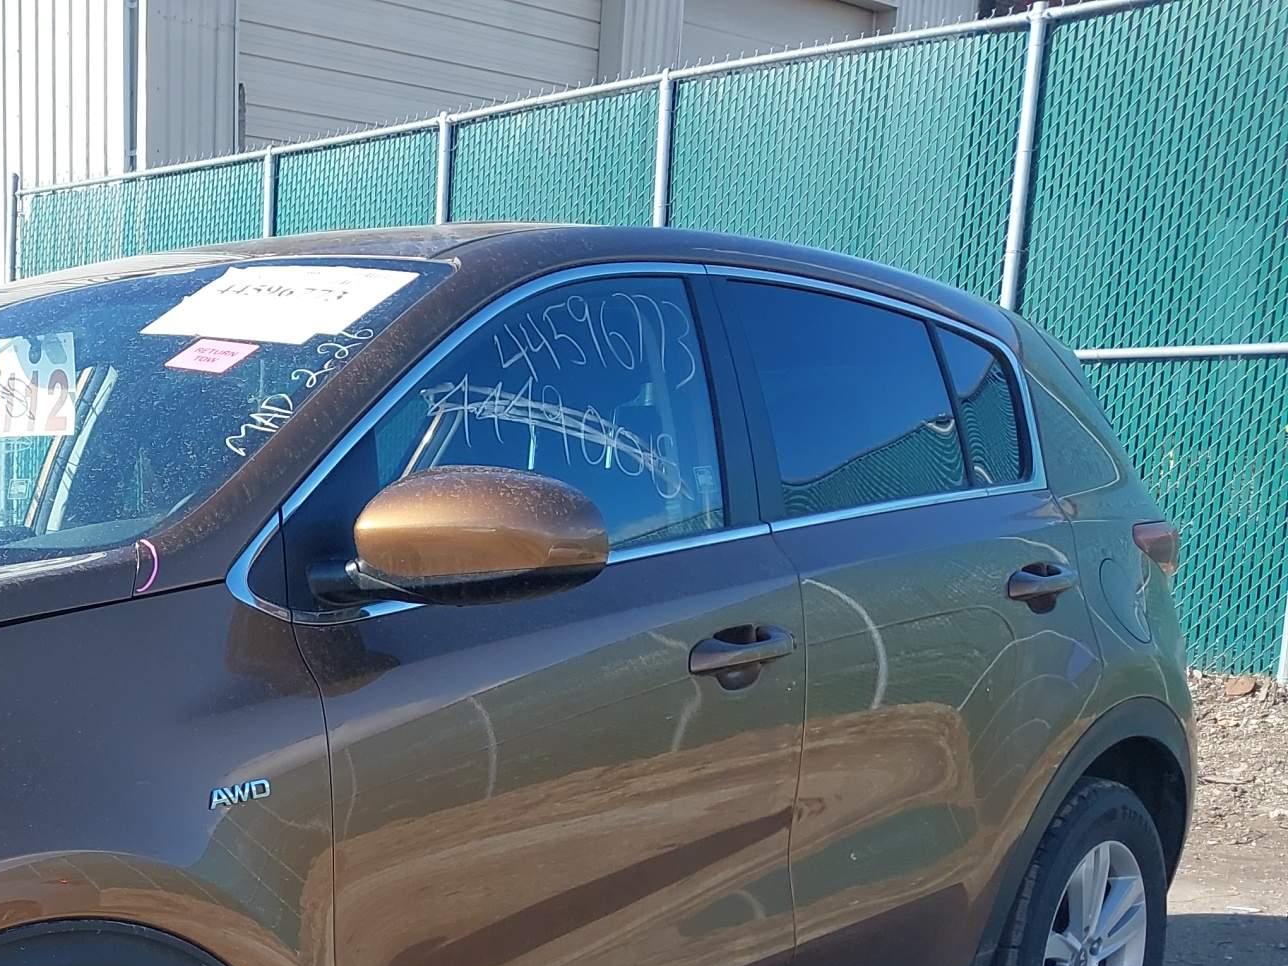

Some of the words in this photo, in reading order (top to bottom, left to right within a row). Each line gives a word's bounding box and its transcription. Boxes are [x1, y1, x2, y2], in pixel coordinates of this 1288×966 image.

[194, 347, 240, 358] RETURN
[493, 292, 696, 390] 44596773
[209, 779, 271, 810] AWD
